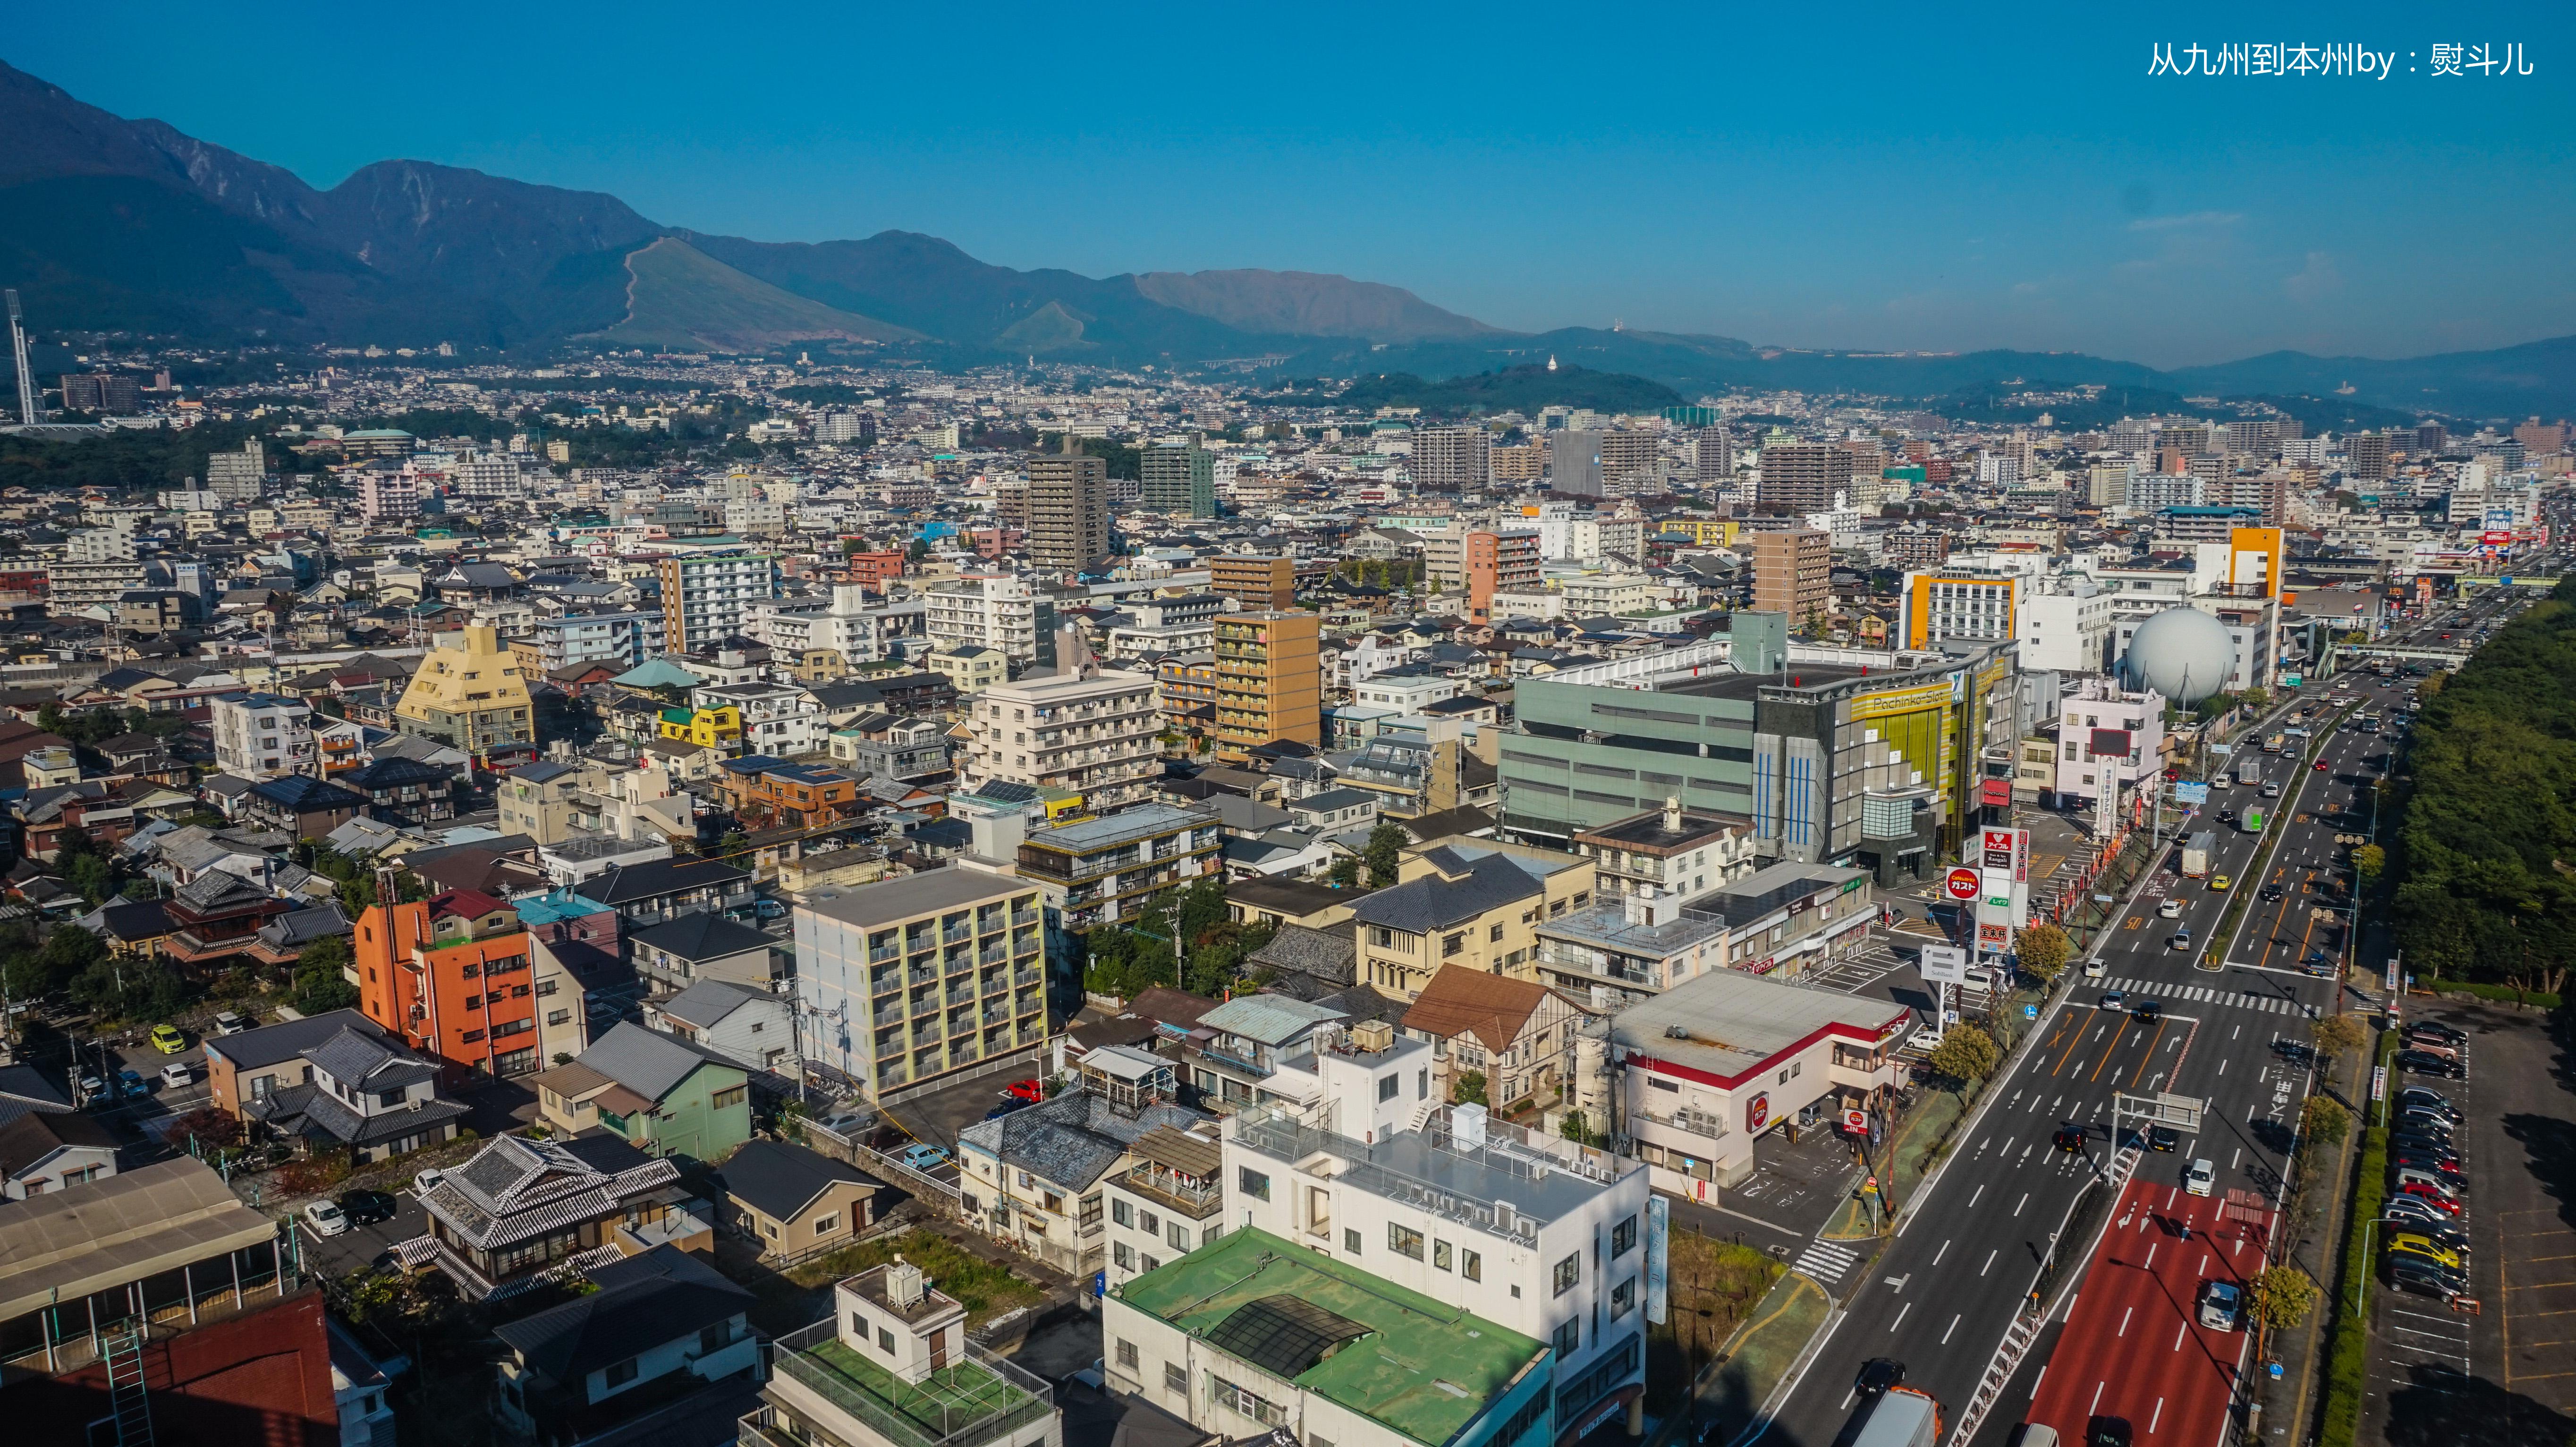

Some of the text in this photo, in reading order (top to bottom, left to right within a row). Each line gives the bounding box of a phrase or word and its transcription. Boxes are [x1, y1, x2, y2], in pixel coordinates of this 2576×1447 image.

[2487, 520, 2509, 530] 青山
[1873, 690, 1943, 710] Pachinko-Slot
[1951, 881, 1976, 891] ガスト
[2124, 916, 2143, 930] 50
[1981, 928, 2006, 940] 宝来軒
[1760, 960, 1773, 971] アイフル
[1932, 970, 1953, 978] SoftBank
[1949, 1012, 1956, 1021] P
[1754, 1108, 1766, 1121] ガスト
[1651, 1207, 1662, 1314] 北浜クリニック
